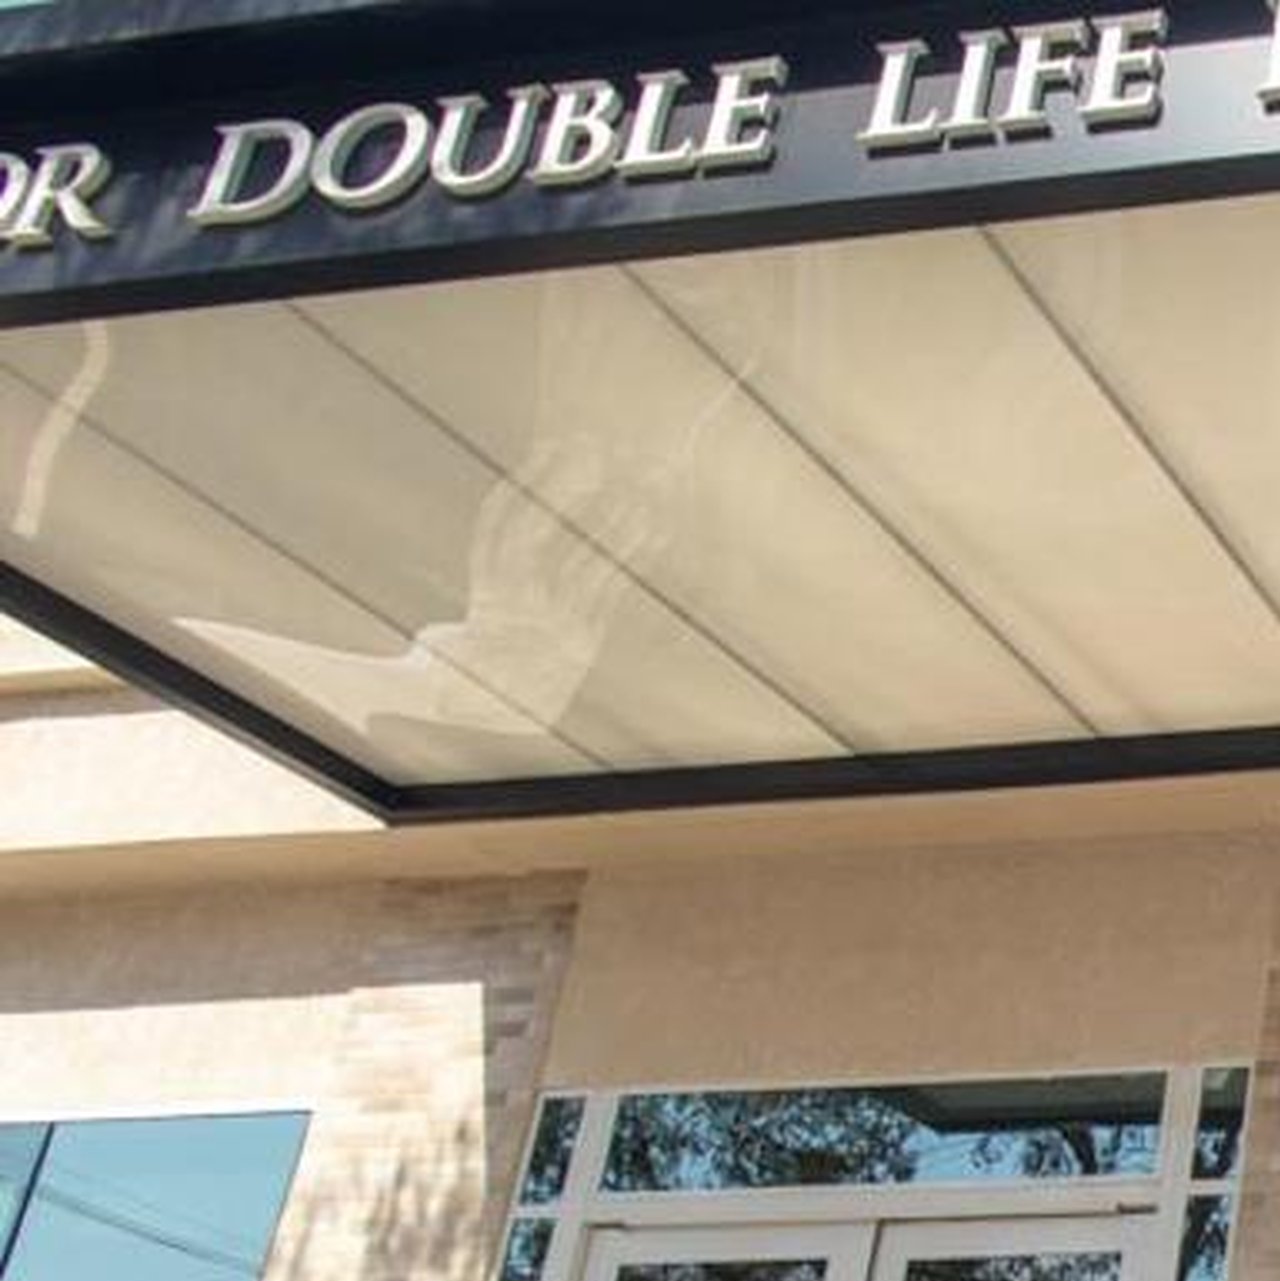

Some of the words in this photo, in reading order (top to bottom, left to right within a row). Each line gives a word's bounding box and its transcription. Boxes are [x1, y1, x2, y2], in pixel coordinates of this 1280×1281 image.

[0, 142, 112, 246] R
[186, 55, 788, 226] DOUBLE
[855, 8, 1168, 150] LIFE
